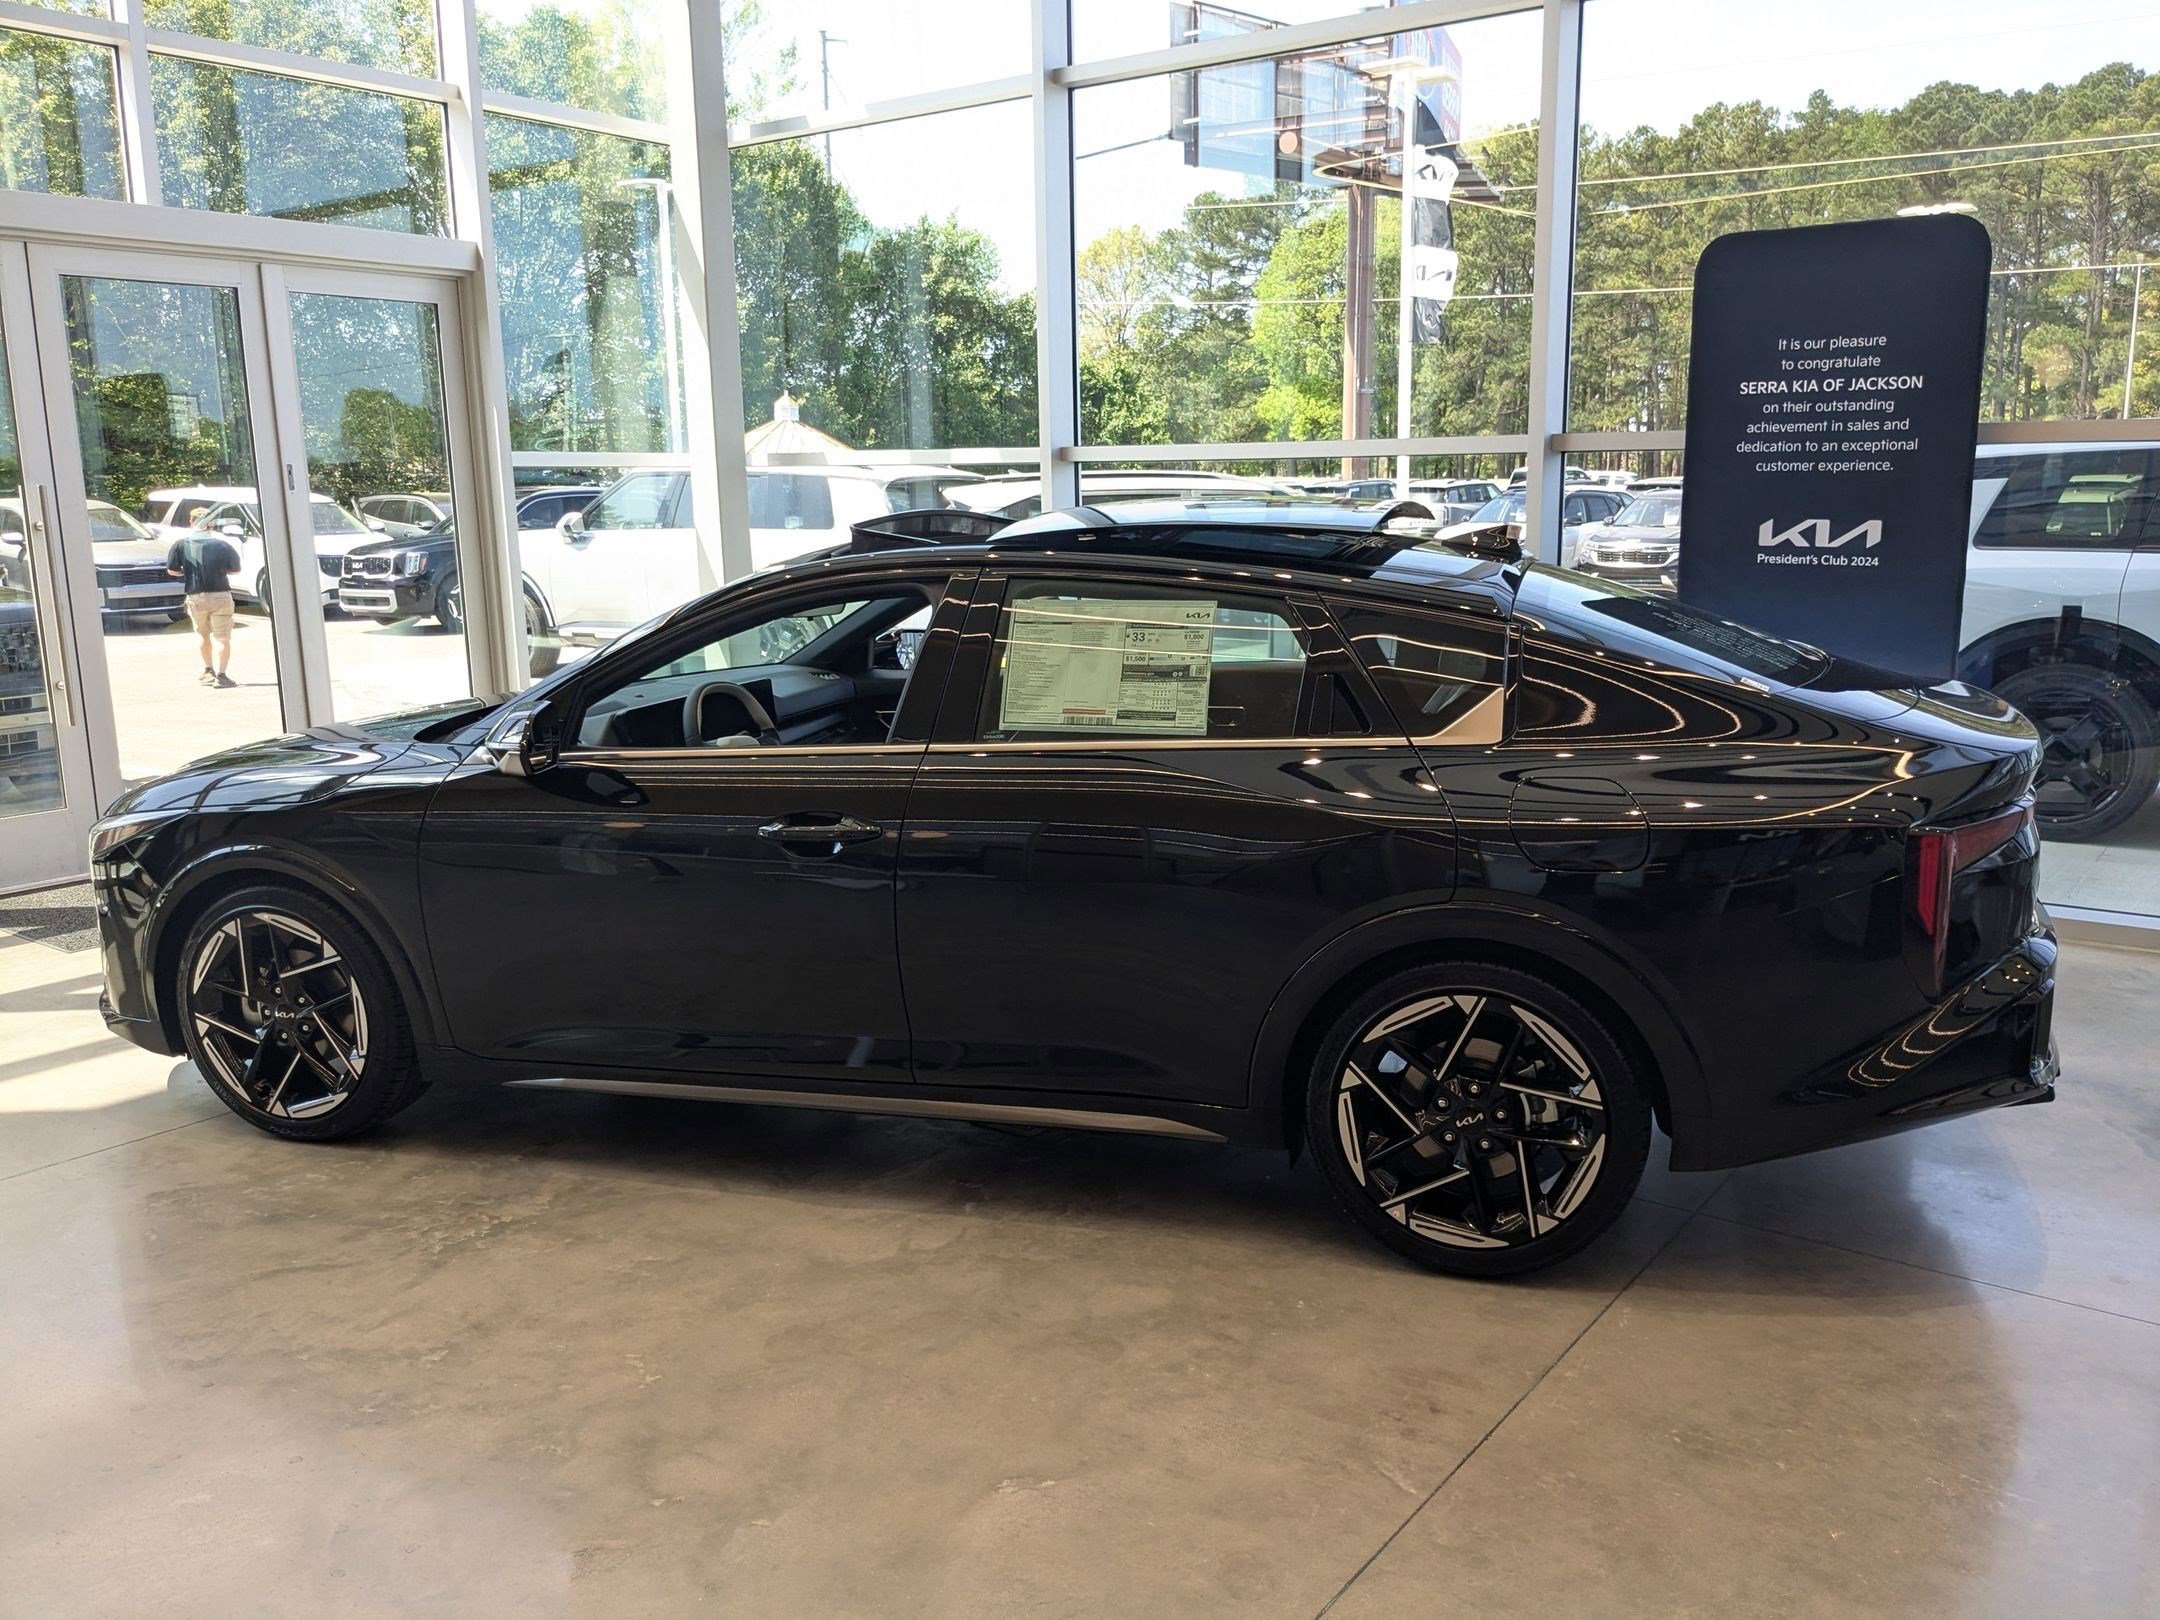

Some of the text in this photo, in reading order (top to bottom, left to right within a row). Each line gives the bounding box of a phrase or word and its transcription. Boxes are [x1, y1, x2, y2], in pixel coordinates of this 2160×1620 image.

[1779, 336, 1886, 351] It is our pleasure
[1781, 355, 1881, 371] to congratulate
[1740, 376, 1923, 394] SERRA KIA OF JACKSON
[1763, 399, 1894, 413] on their outstanding
[1747, 418, 1909, 433] achievement in sales and
[1737, 438, 1918, 453] dedication to an exceptional
[1756, 460, 1893, 473] customer experience.
[1758, 519, 1882, 548] KIA
[1757, 554, 1878, 566] President's Club 2024
[1131, 632, 1146, 642] 33
[1455, 1112, 1485, 1128] KIA
